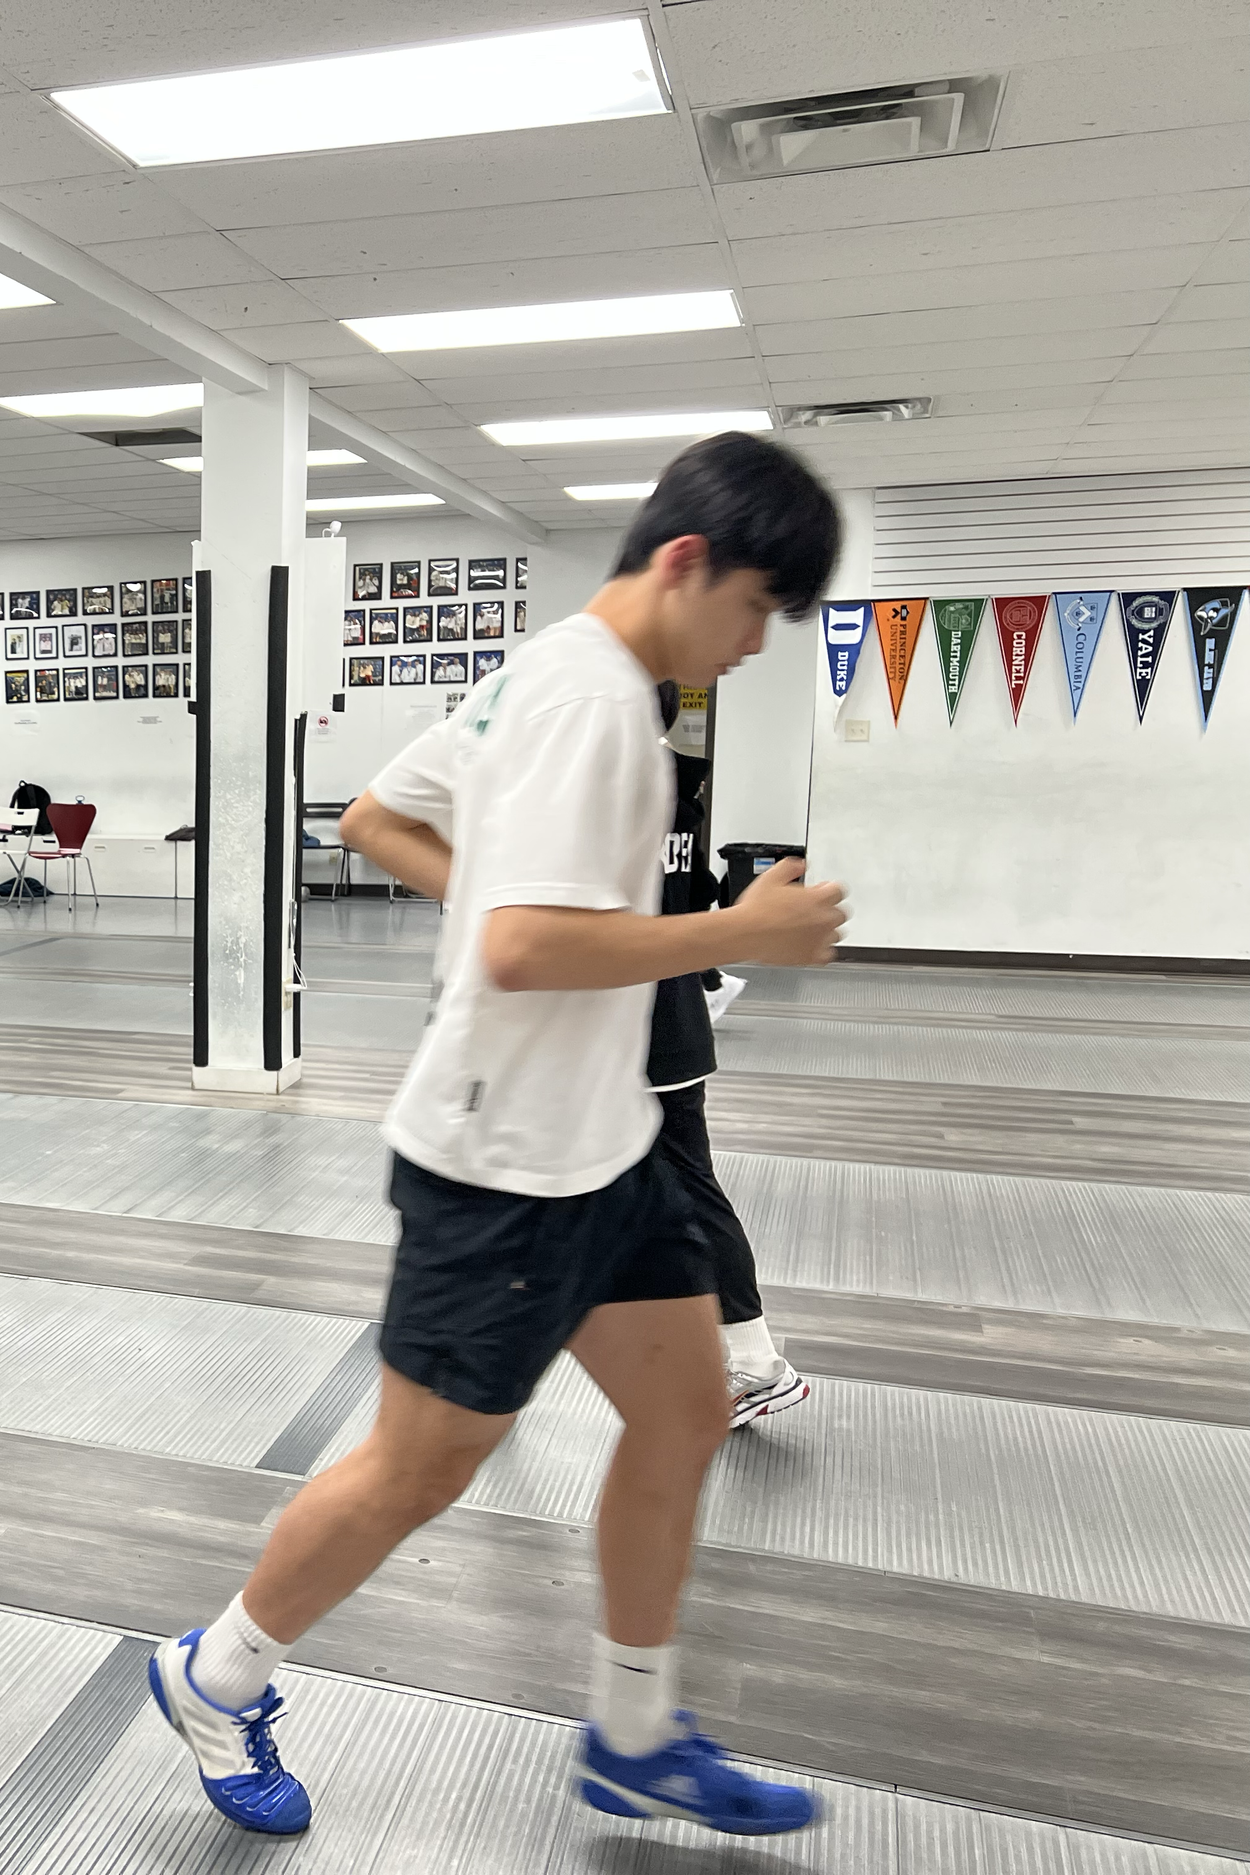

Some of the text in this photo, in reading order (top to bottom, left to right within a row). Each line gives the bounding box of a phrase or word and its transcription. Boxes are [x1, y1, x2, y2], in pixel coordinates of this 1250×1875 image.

[836, 651, 849, 691] DUKE
[889, 623, 898, 682] UNIVERSITY
[897, 623, 907, 681] PRINCETON
[948, 630, 962, 693] DARTMOUTH
[1011, 631, 1026, 689] CORNELL
[1072, 632, 1087, 692] COLUMBIA
[1136, 629, 1154, 680] YALE
